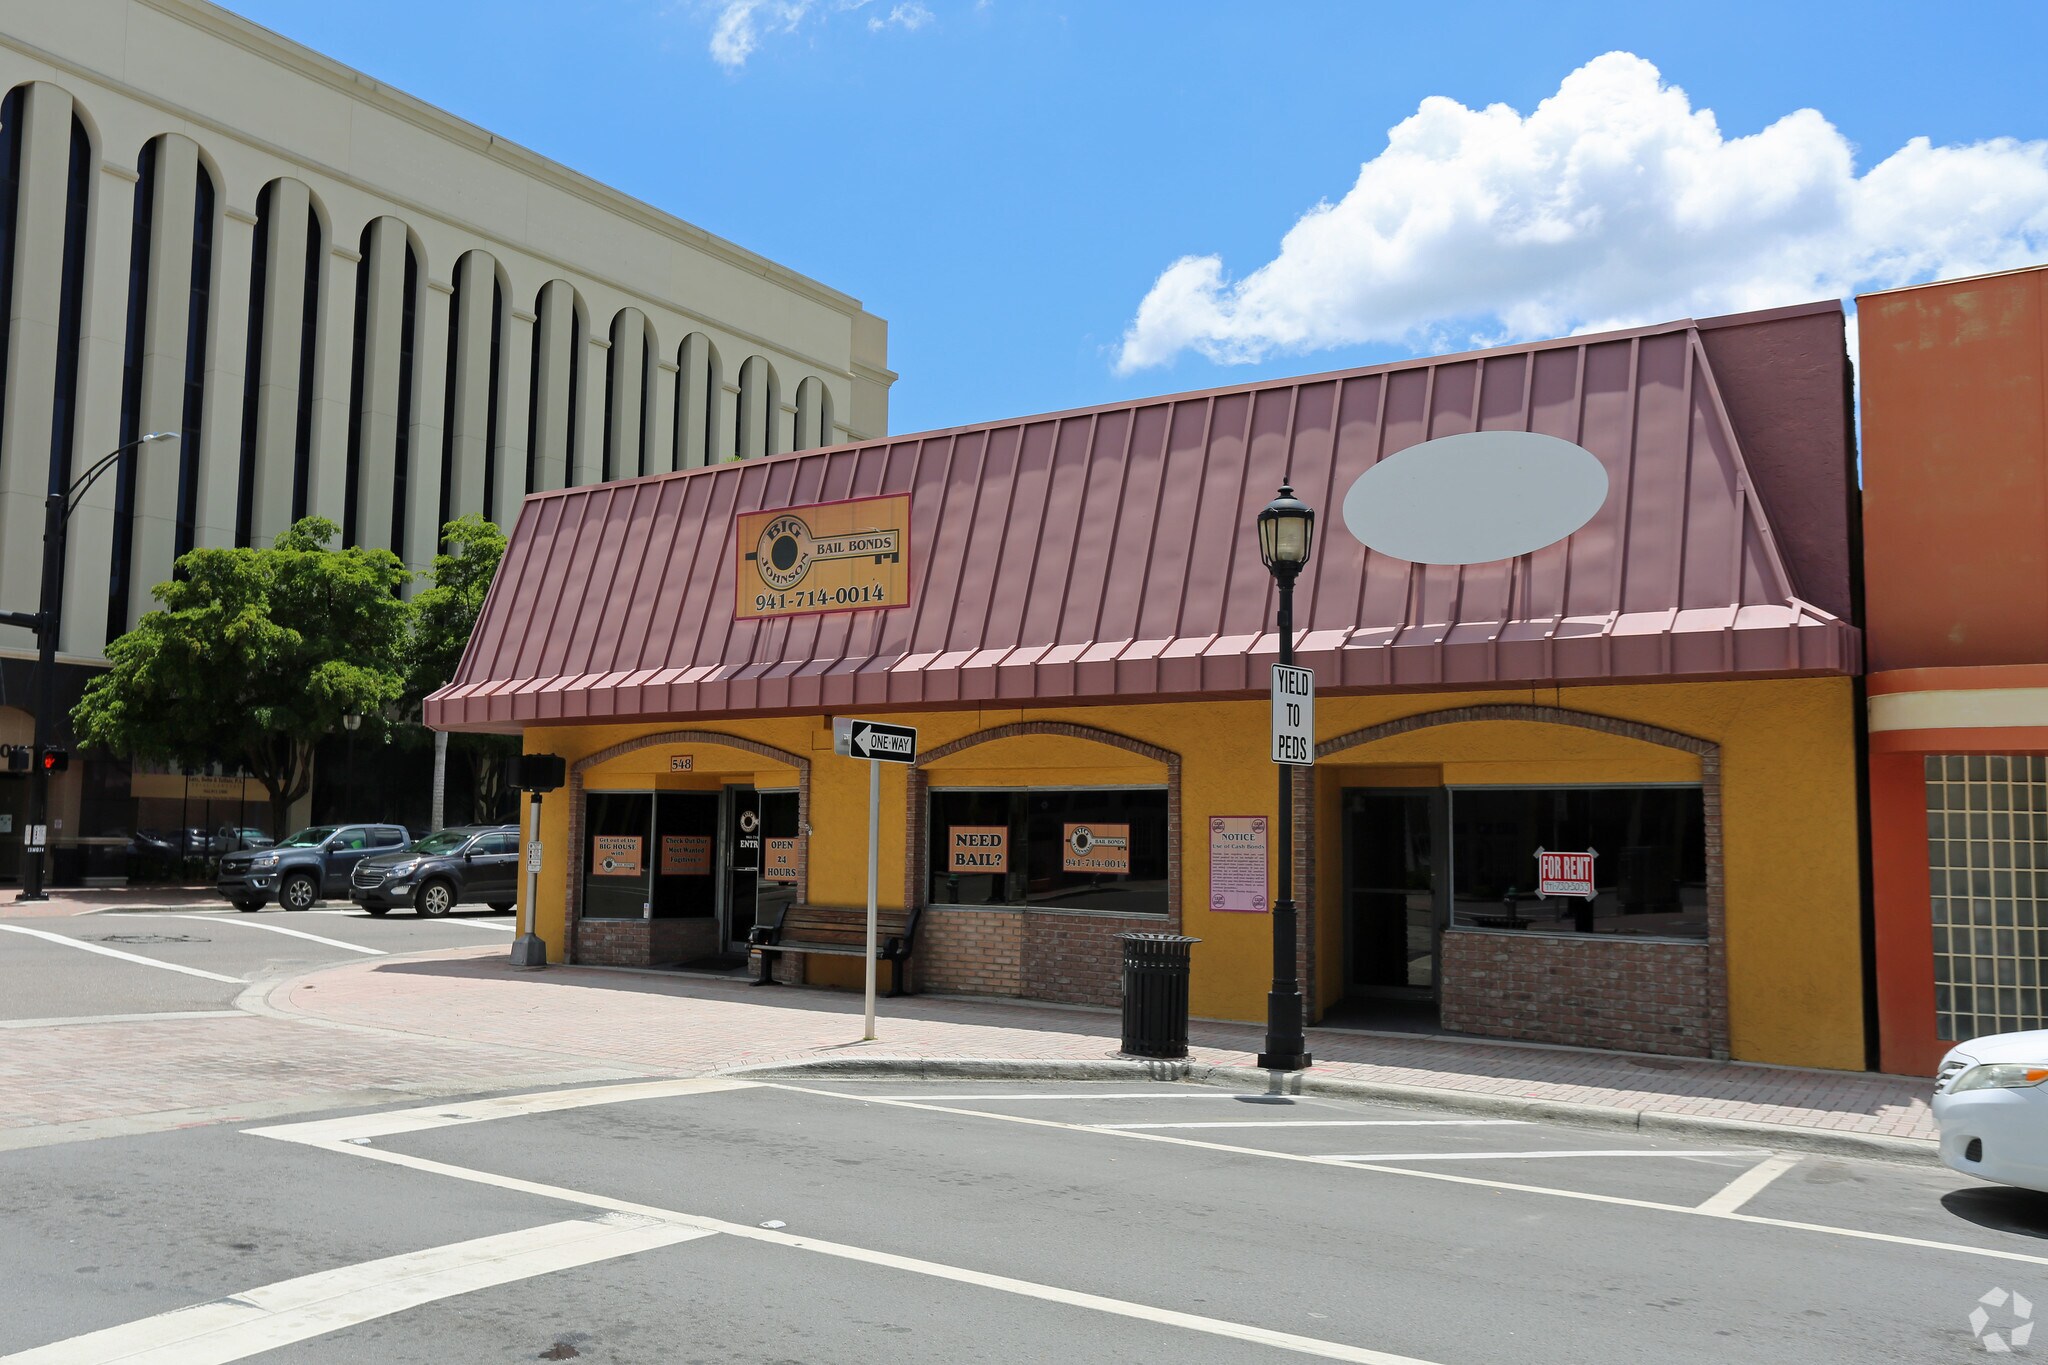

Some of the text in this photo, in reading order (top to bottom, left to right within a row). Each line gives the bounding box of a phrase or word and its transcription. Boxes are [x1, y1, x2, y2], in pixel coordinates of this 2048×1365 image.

[766, 520, 802, 541] BIG
[817, 537, 892, 555] BAIL BONDS
[761, 552, 809, 584] JOHNSON
[755, 583, 885, 611] 941-714-0014
[1278, 668, 1308, 696] YIELD
[1286, 702, 1300, 727] TO
[870, 734, 910, 751] ONE WAY
[1278, 734, 1307, 760] PEDS
[672, 758, 691, 770] 548
[1074, 827, 1089, 836] BIG
[1221, 833, 1255, 841] NOTICE
[771, 840, 794, 849] OPEN
[955, 833, 1002, 847] NEED
[777, 855, 787, 864] 24
[955, 853, 1002, 866] BAIL?
[1065, 858, 1127, 868] 941-714-0014
[767, 867, 797, 877] HOURS
[1542, 855, 1590, 880] FOR RENT
